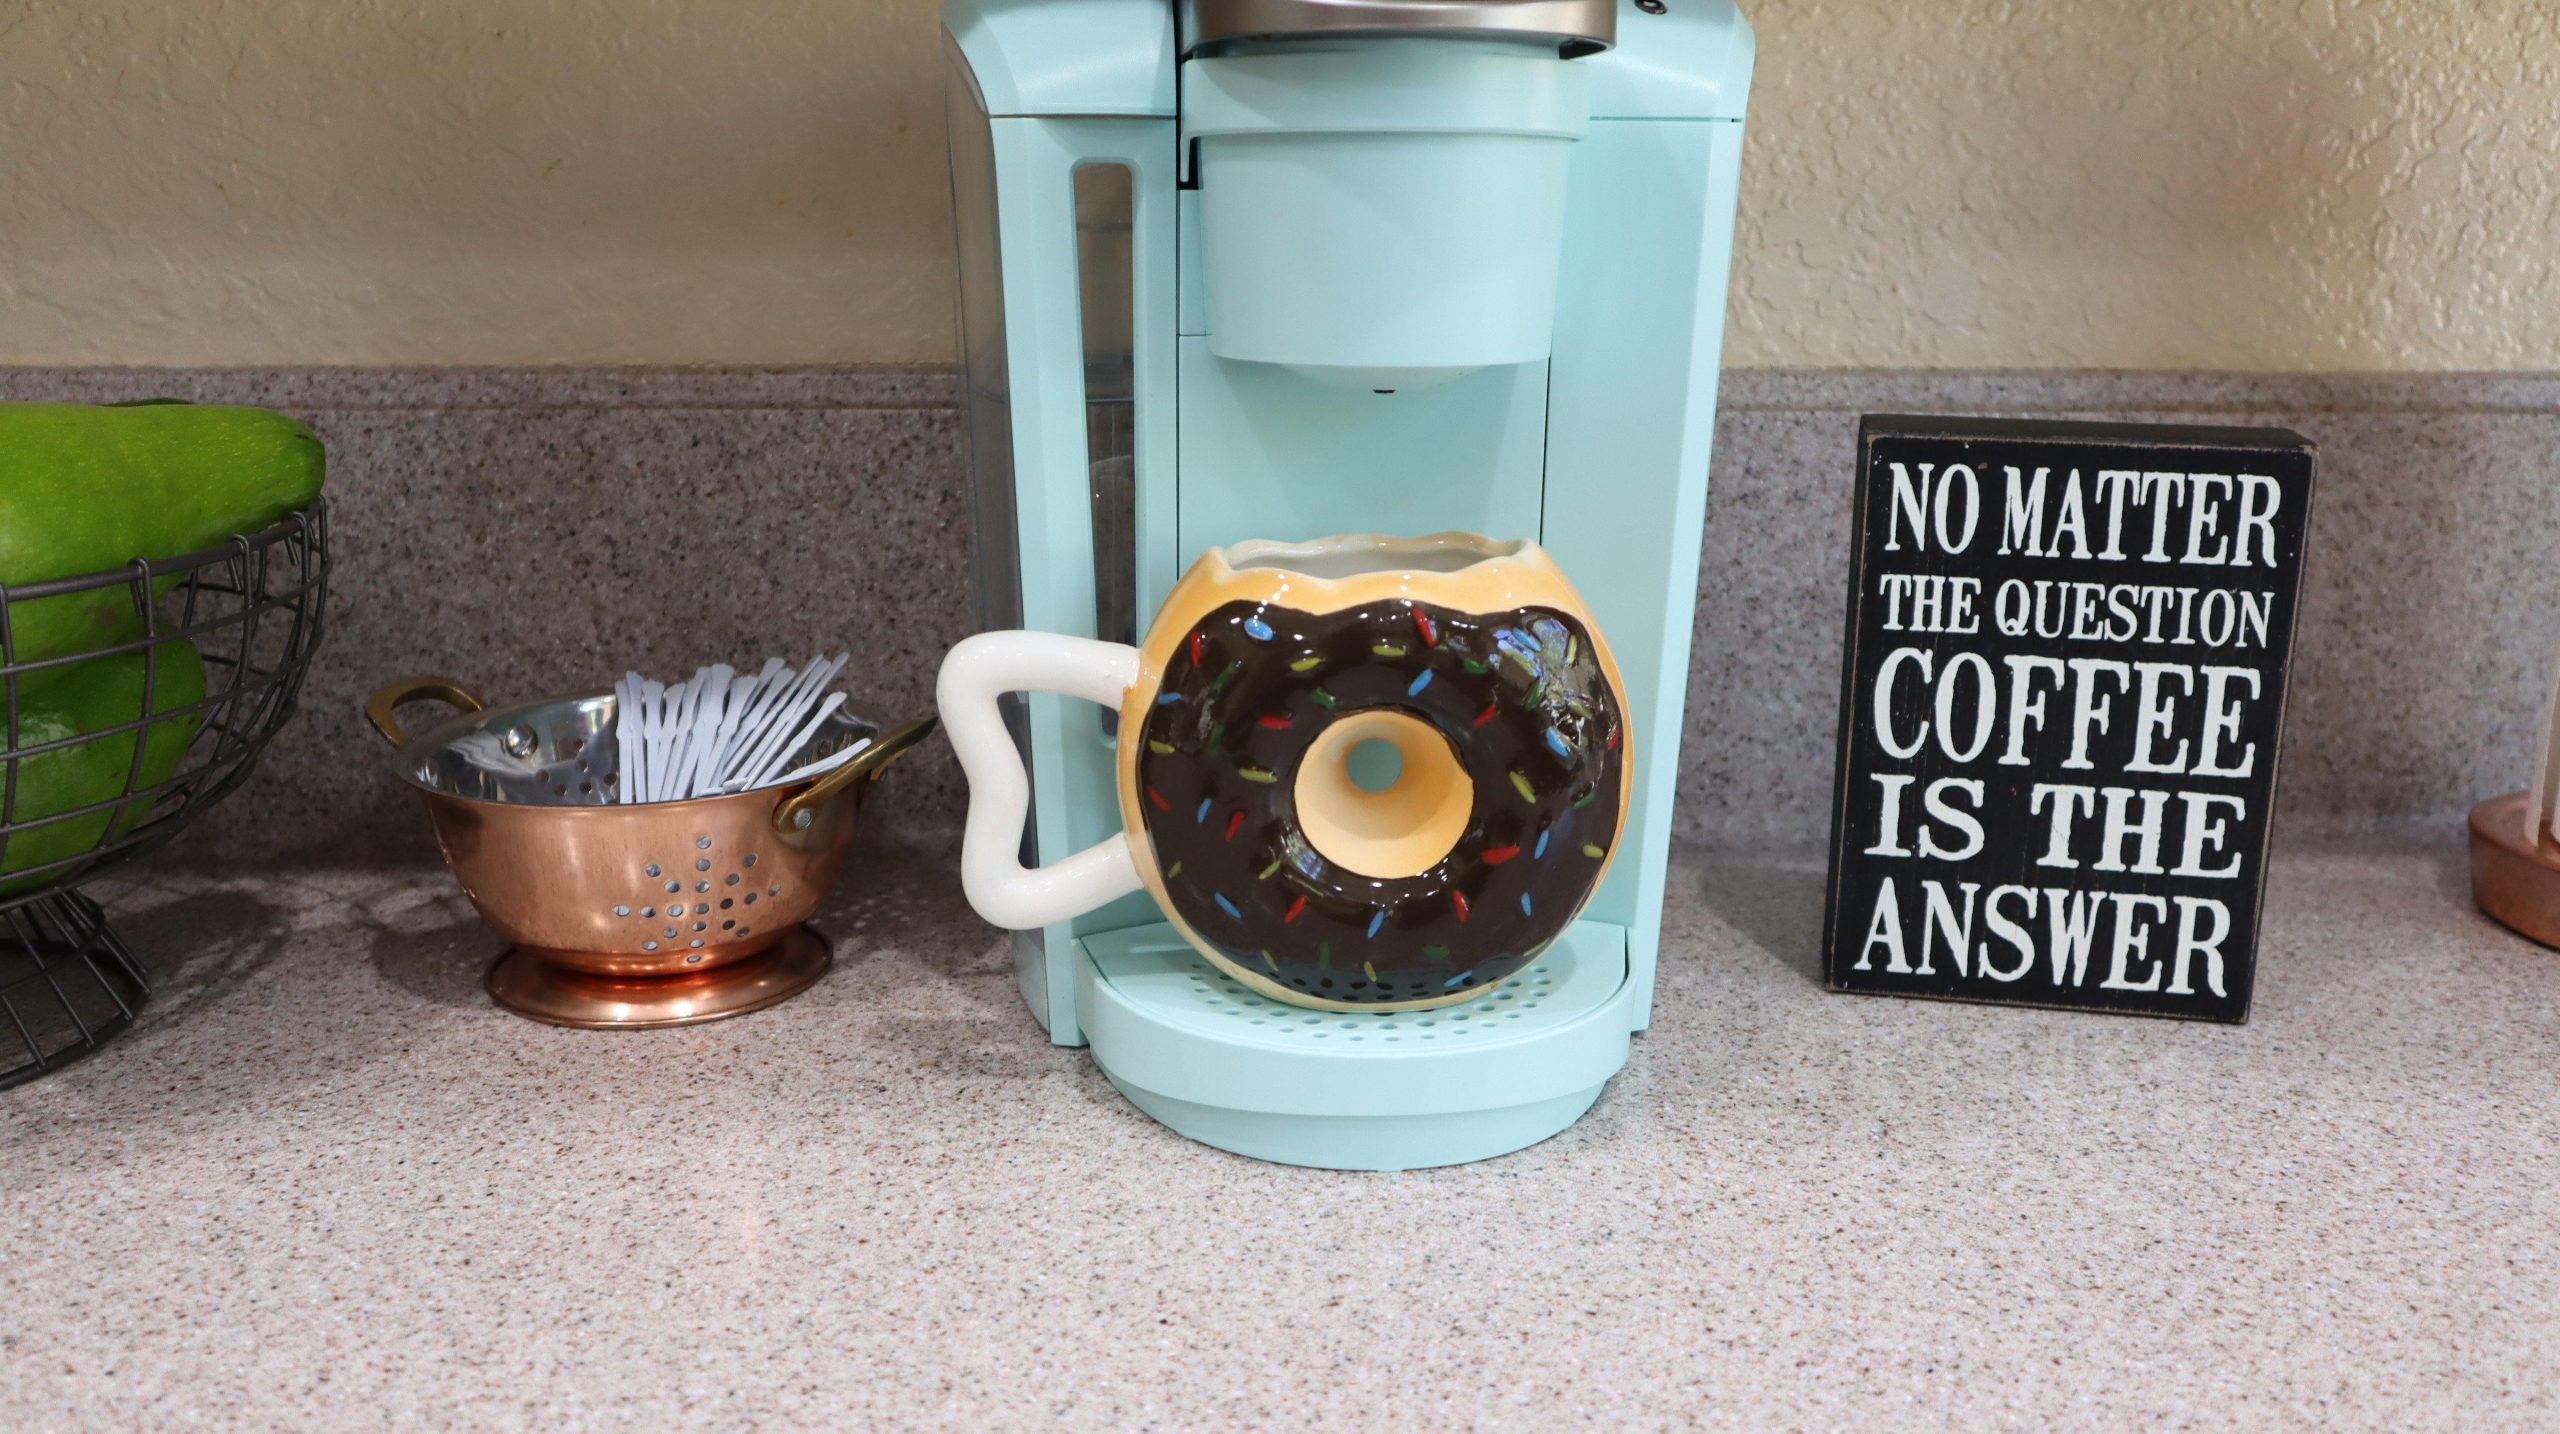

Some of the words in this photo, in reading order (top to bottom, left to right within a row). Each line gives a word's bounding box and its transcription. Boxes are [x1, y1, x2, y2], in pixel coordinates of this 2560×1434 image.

[1885, 462, 1980, 555] NO
[1998, 465, 2282, 568] MATTER
[1880, 573, 1982, 634] THE
[1995, 578, 2275, 649] QUESTION
[1874, 647, 2261, 778] COFFEE
[1864, 773, 1985, 862] IS
[2031, 782, 2246, 879] THE
[1854, 876, 2233, 998] ANSWER
